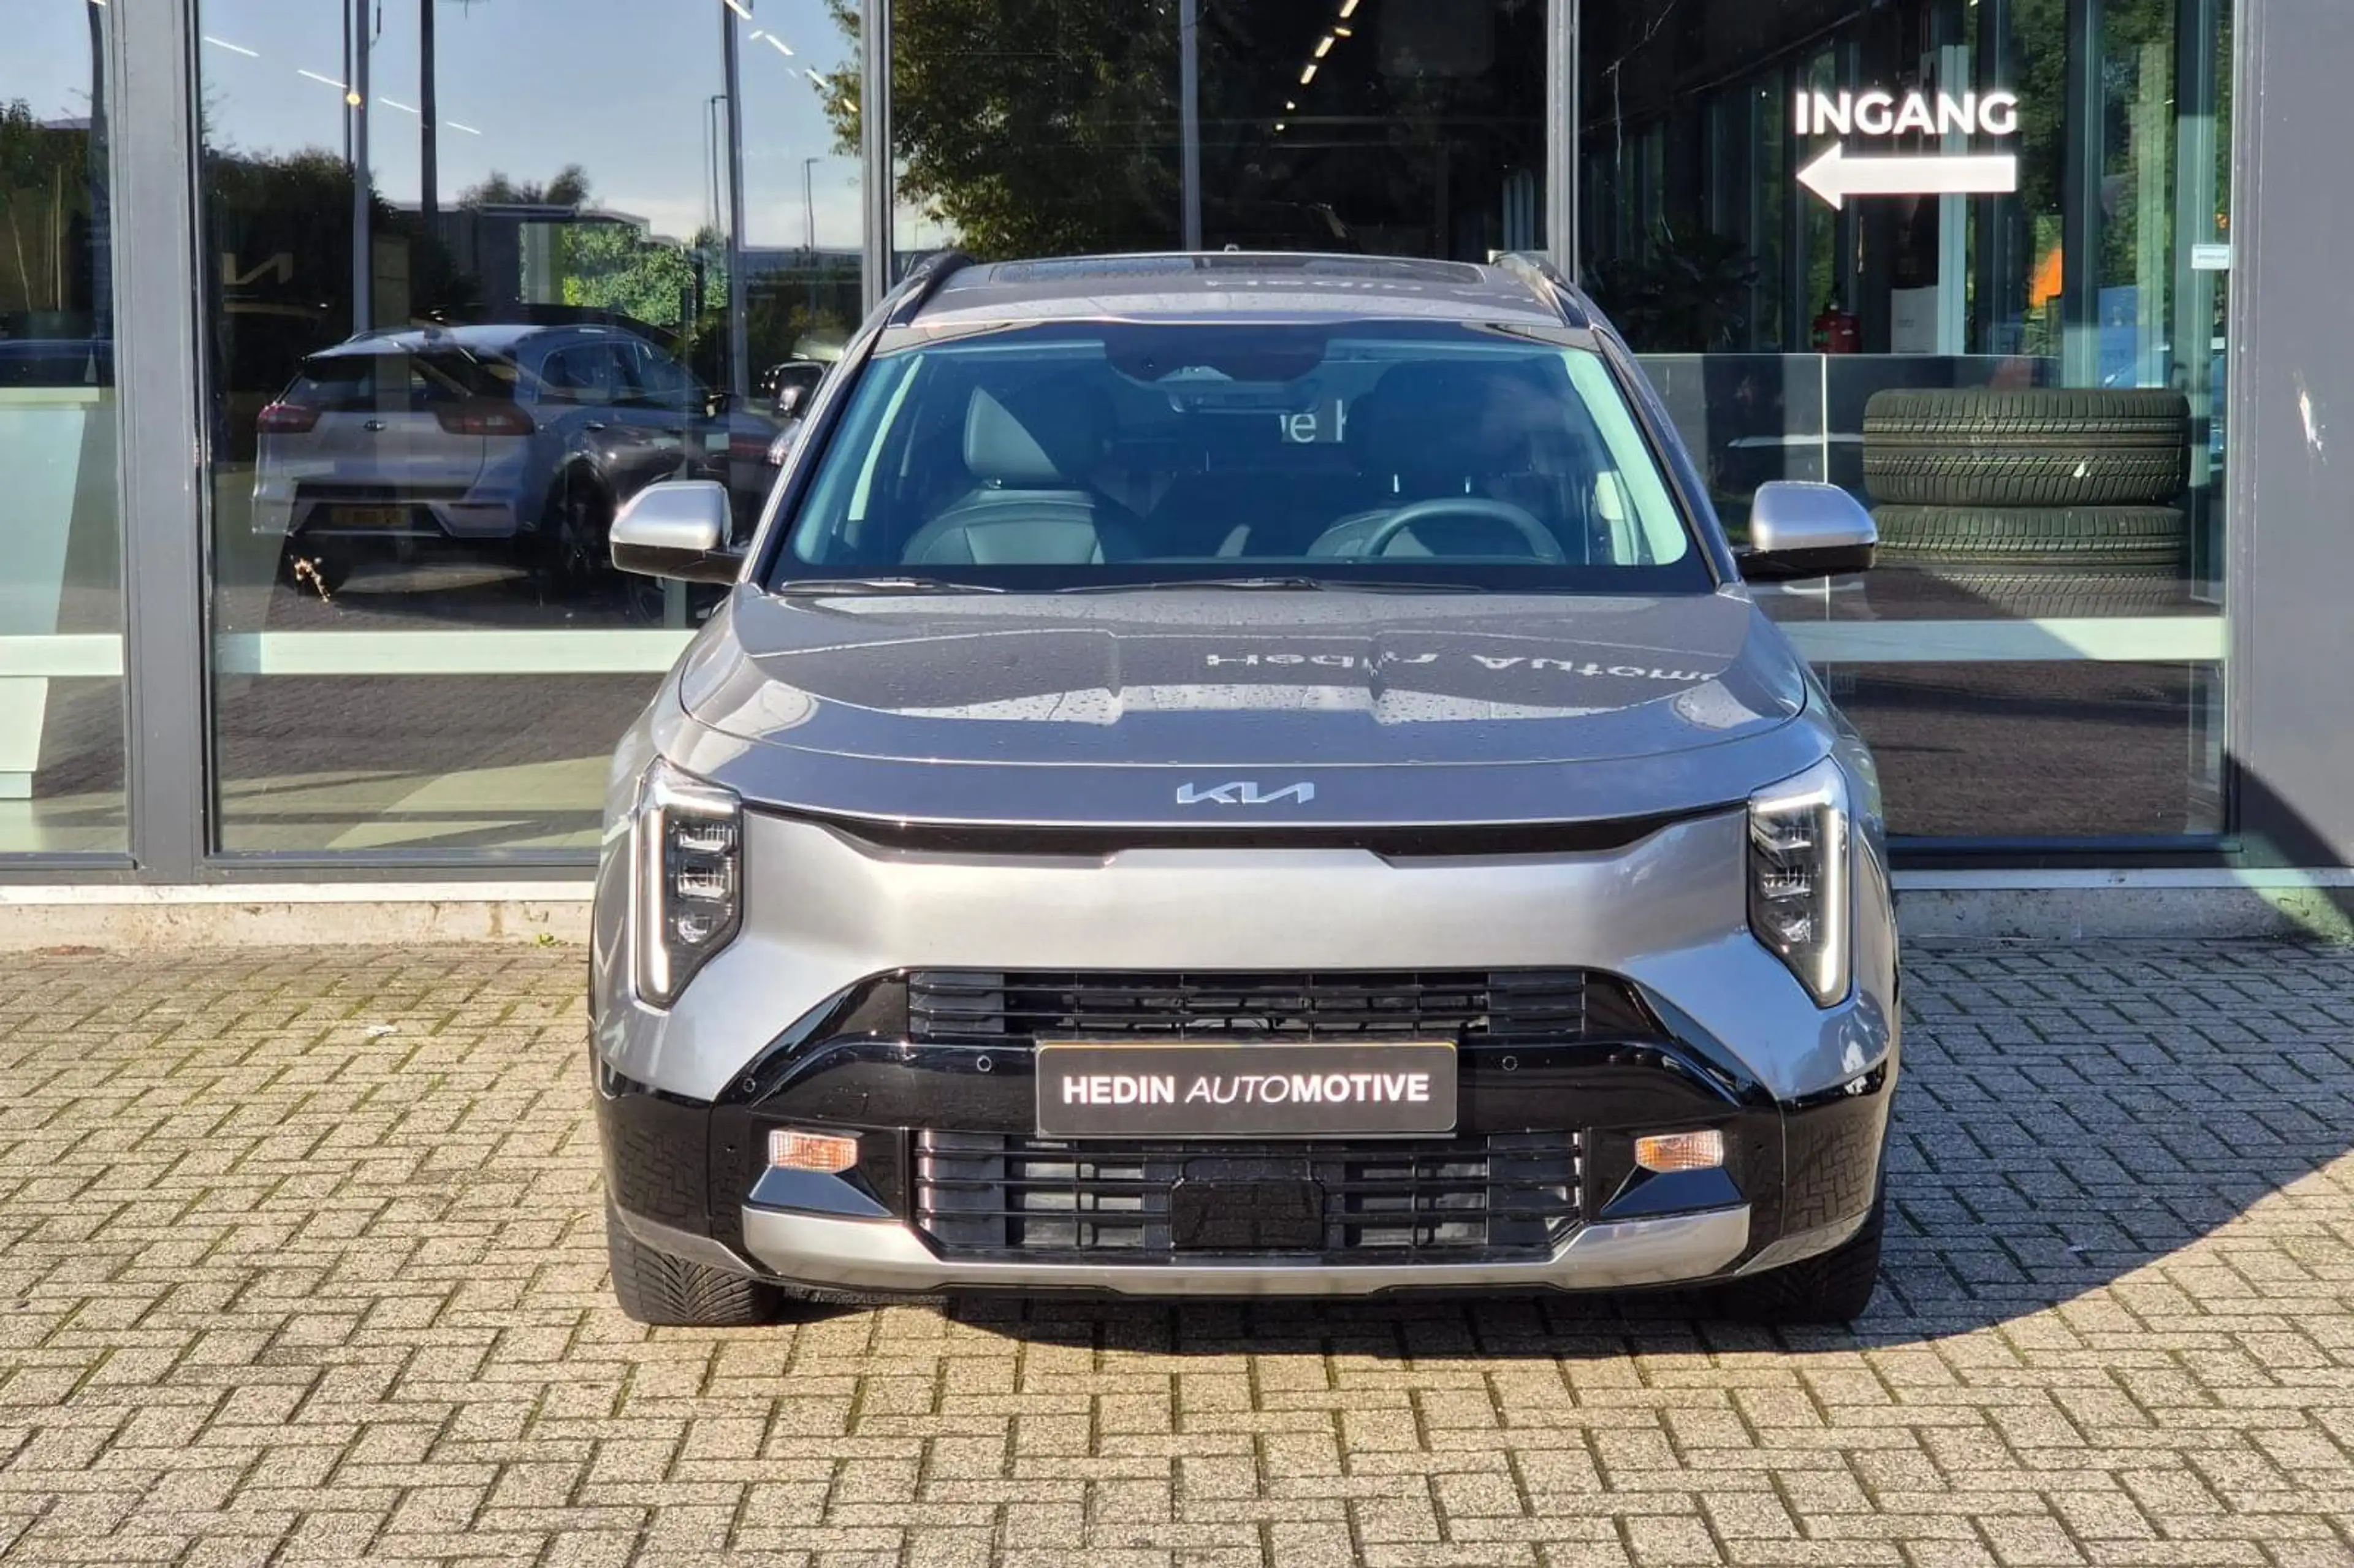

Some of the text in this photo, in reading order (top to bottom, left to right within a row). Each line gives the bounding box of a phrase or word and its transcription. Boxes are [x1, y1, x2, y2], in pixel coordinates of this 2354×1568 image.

[1796, 92, 2018, 135] INGANG
[1177, 782, 1314, 804] KIA
[1063, 1074, 1430, 1104] HEDIN AUTOMOTIVE
